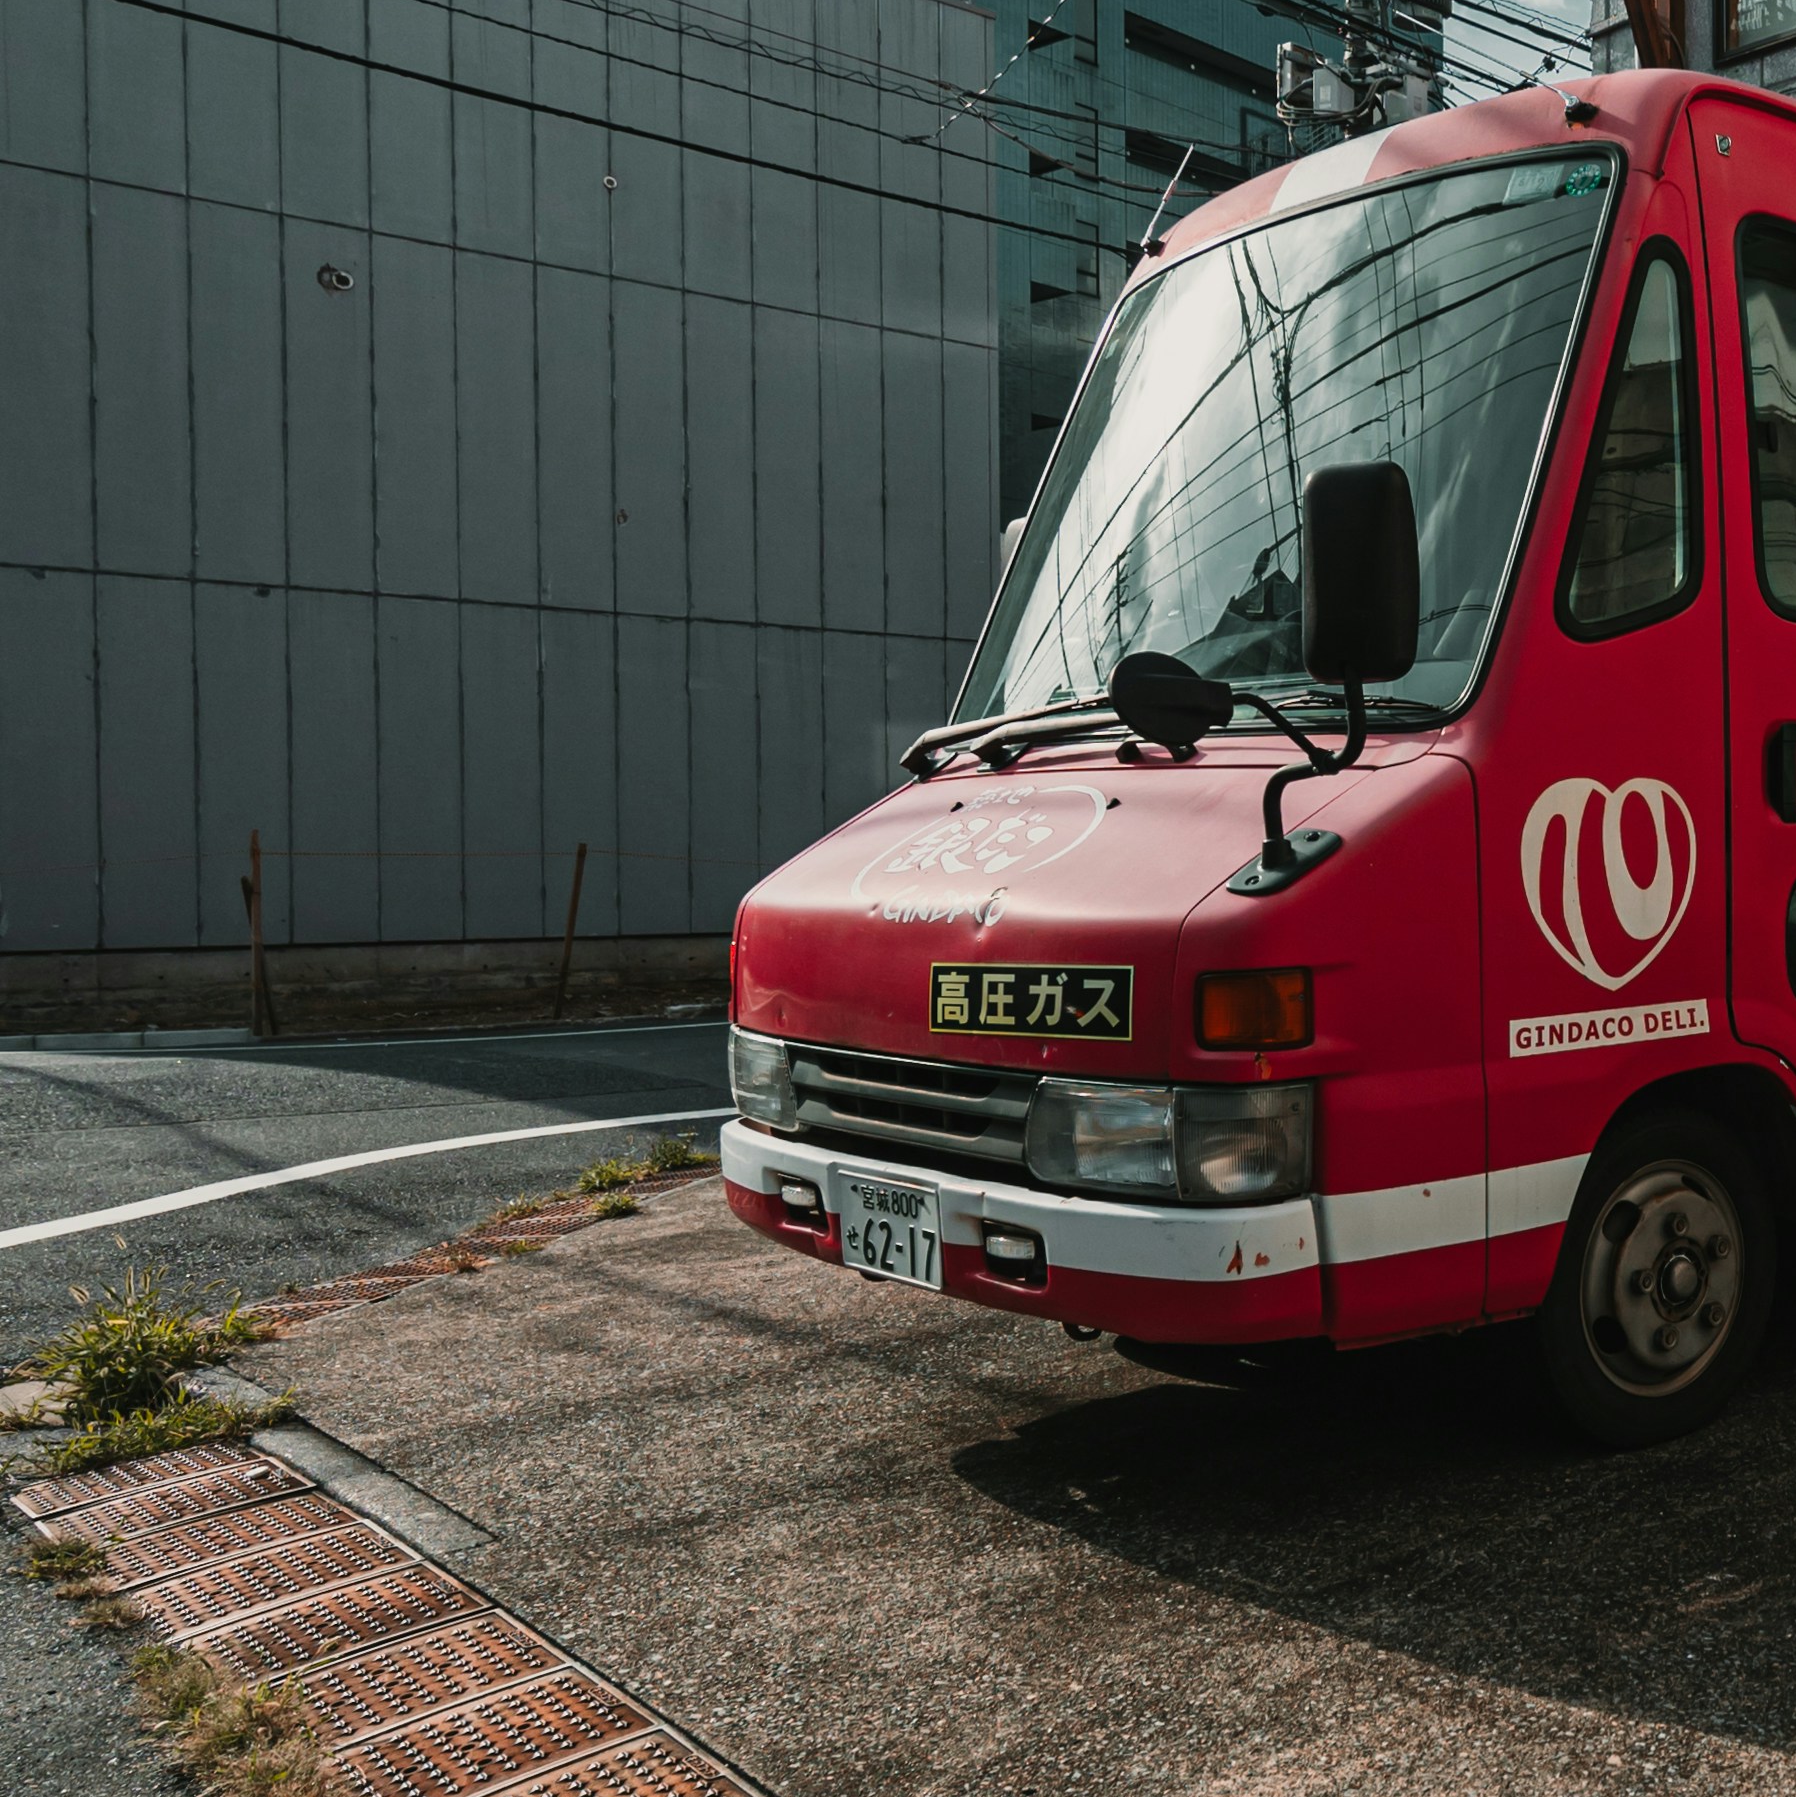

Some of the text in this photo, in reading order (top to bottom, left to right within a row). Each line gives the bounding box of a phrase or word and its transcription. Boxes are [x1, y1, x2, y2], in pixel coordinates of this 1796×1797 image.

[937, 971, 1120, 1028] 高圧ガス
[1515, 1007, 1705, 1050] GINDACO DELI.
